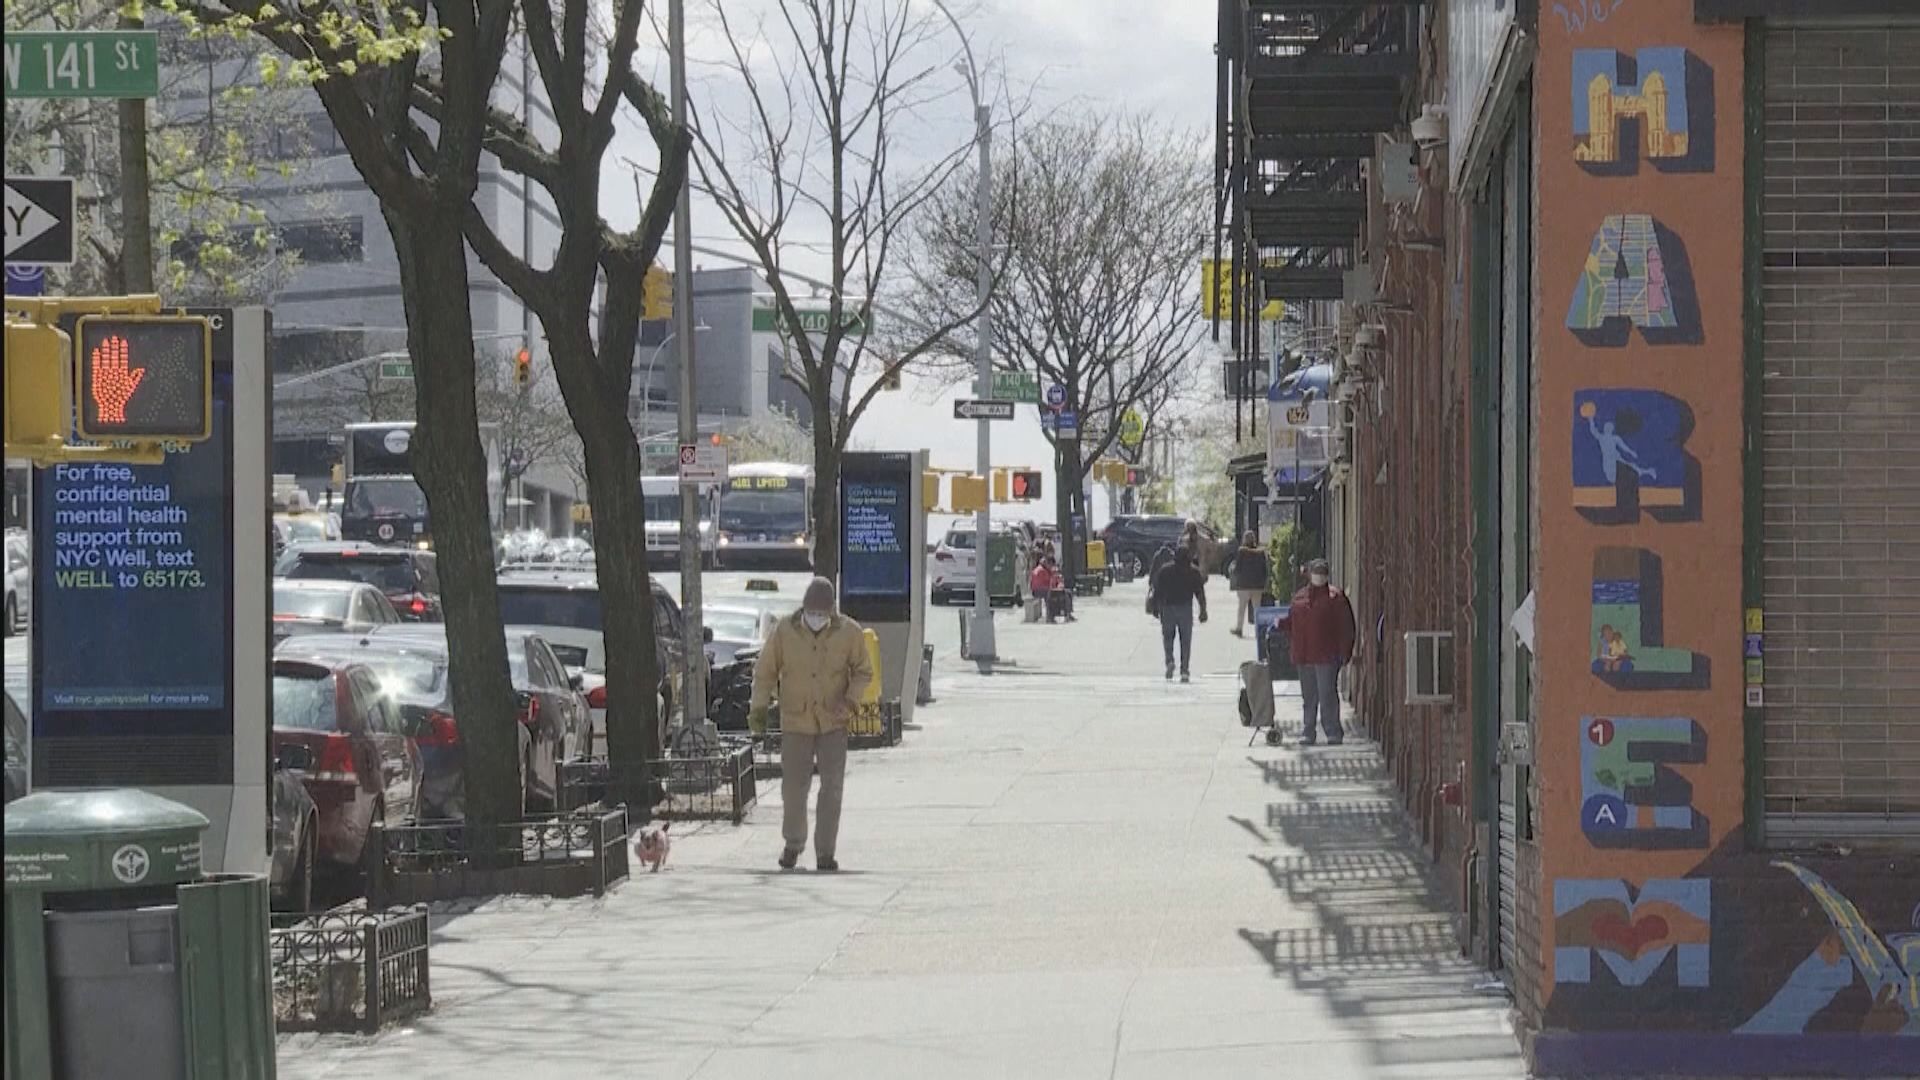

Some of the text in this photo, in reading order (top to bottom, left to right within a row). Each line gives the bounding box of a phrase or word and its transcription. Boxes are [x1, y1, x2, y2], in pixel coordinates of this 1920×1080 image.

[43, 42, 95, 89] 141
[115, 40, 139, 70] St
[989, 404, 1007, 415] WAY
[55, 464, 137, 483] For free,
[756, 478, 788, 489] LIMITED
[55, 484, 170, 501] confidential
[55, 507, 187, 523] mental health
[55, 529, 183, 548] support from
[55, 550, 194, 568] NYC Well, text
[55, 571, 206, 588] WELL to 65173.
[151, 694, 165, 704] for
[191, 694, 209, 704] info
[1592, 724, 1604, 745] 1
[1595, 804, 1616, 824] A
